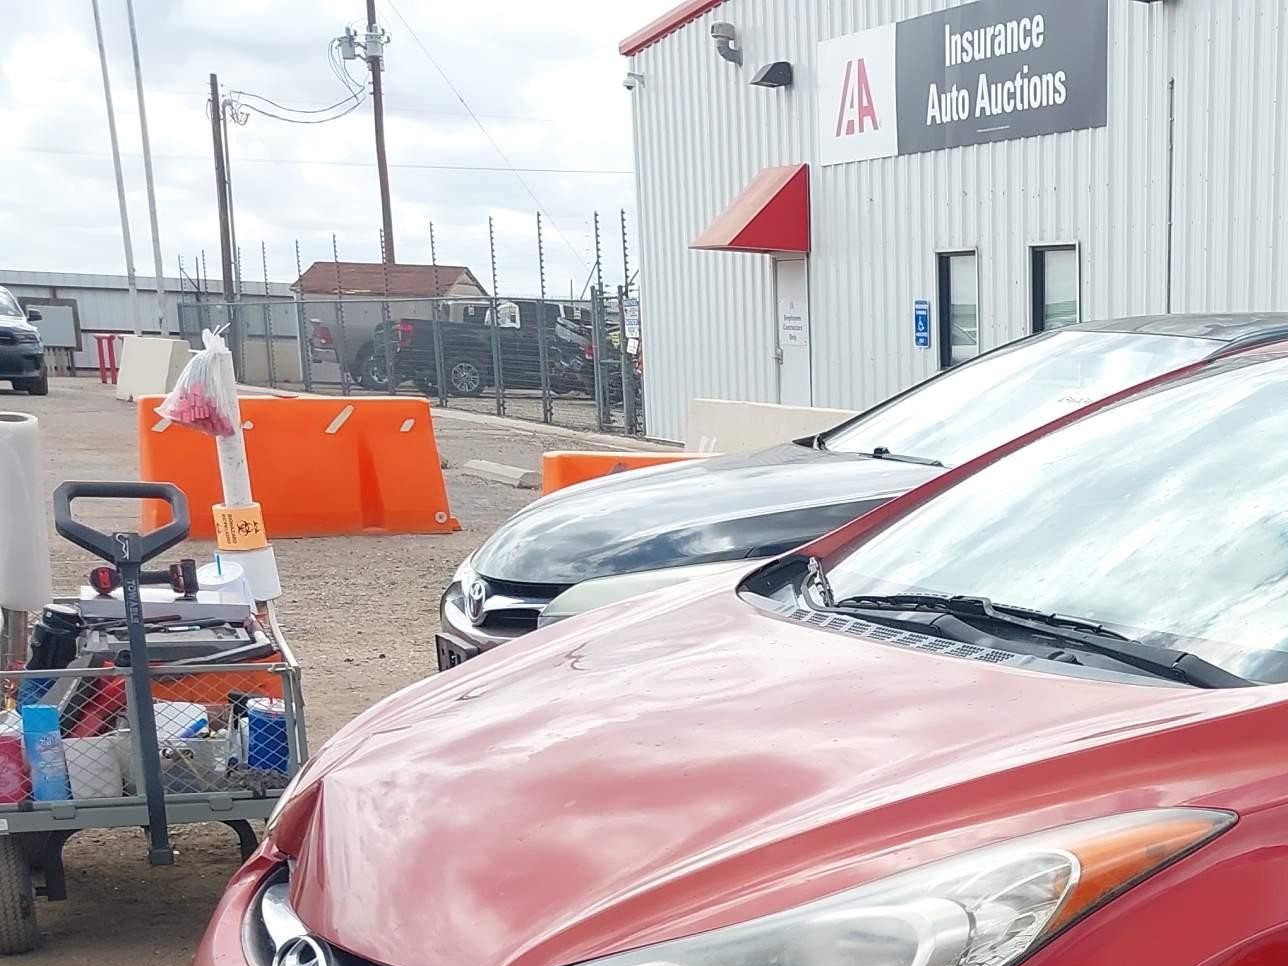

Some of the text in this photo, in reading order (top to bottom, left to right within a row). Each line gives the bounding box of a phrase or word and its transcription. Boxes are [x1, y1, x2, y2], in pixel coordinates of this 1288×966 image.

[944, 14, 1045, 67] Insurance
[926, 65, 1067, 126] Auto Auctions
